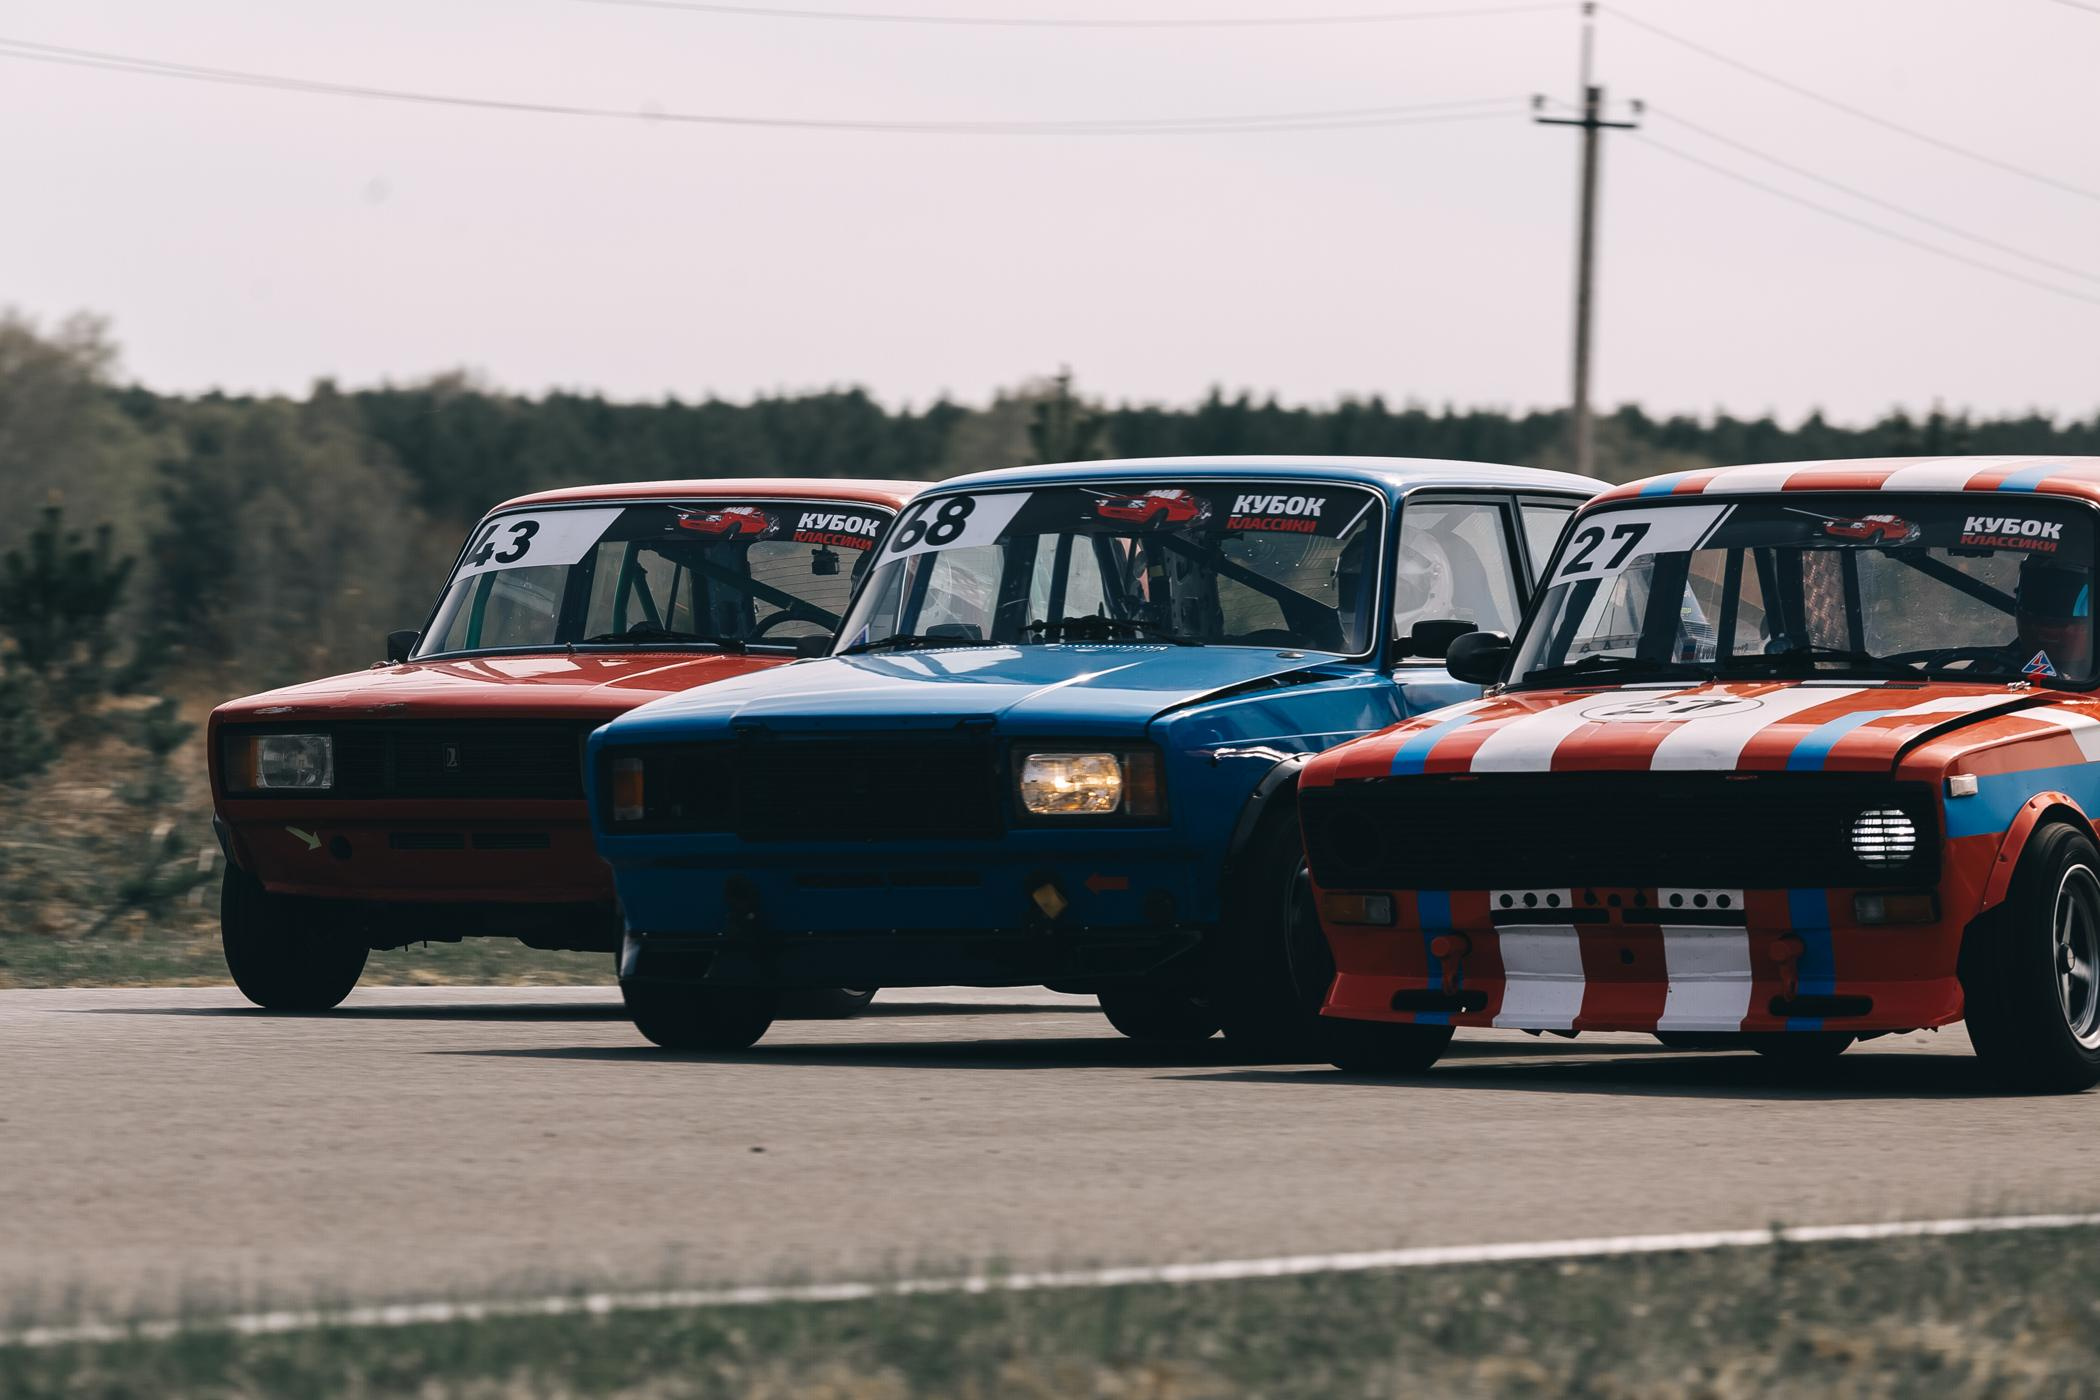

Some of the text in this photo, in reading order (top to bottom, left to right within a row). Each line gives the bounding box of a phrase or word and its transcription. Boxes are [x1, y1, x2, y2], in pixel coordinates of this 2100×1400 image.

[1232, 495, 1326, 516] КУБОК
[798, 513, 880, 537] КУБОК
[891, 496, 976, 553] 68
[1227, 517, 1317, 533] КЛАССИКИ
[1963, 516, 2063, 539] КУБОК
[463, 520, 540, 567] 43
[793, 531, 874, 551] КЛАССИКИ
[1560, 523, 1651, 577] 27
[1960, 534, 2058, 552] КЛАССИКИ
